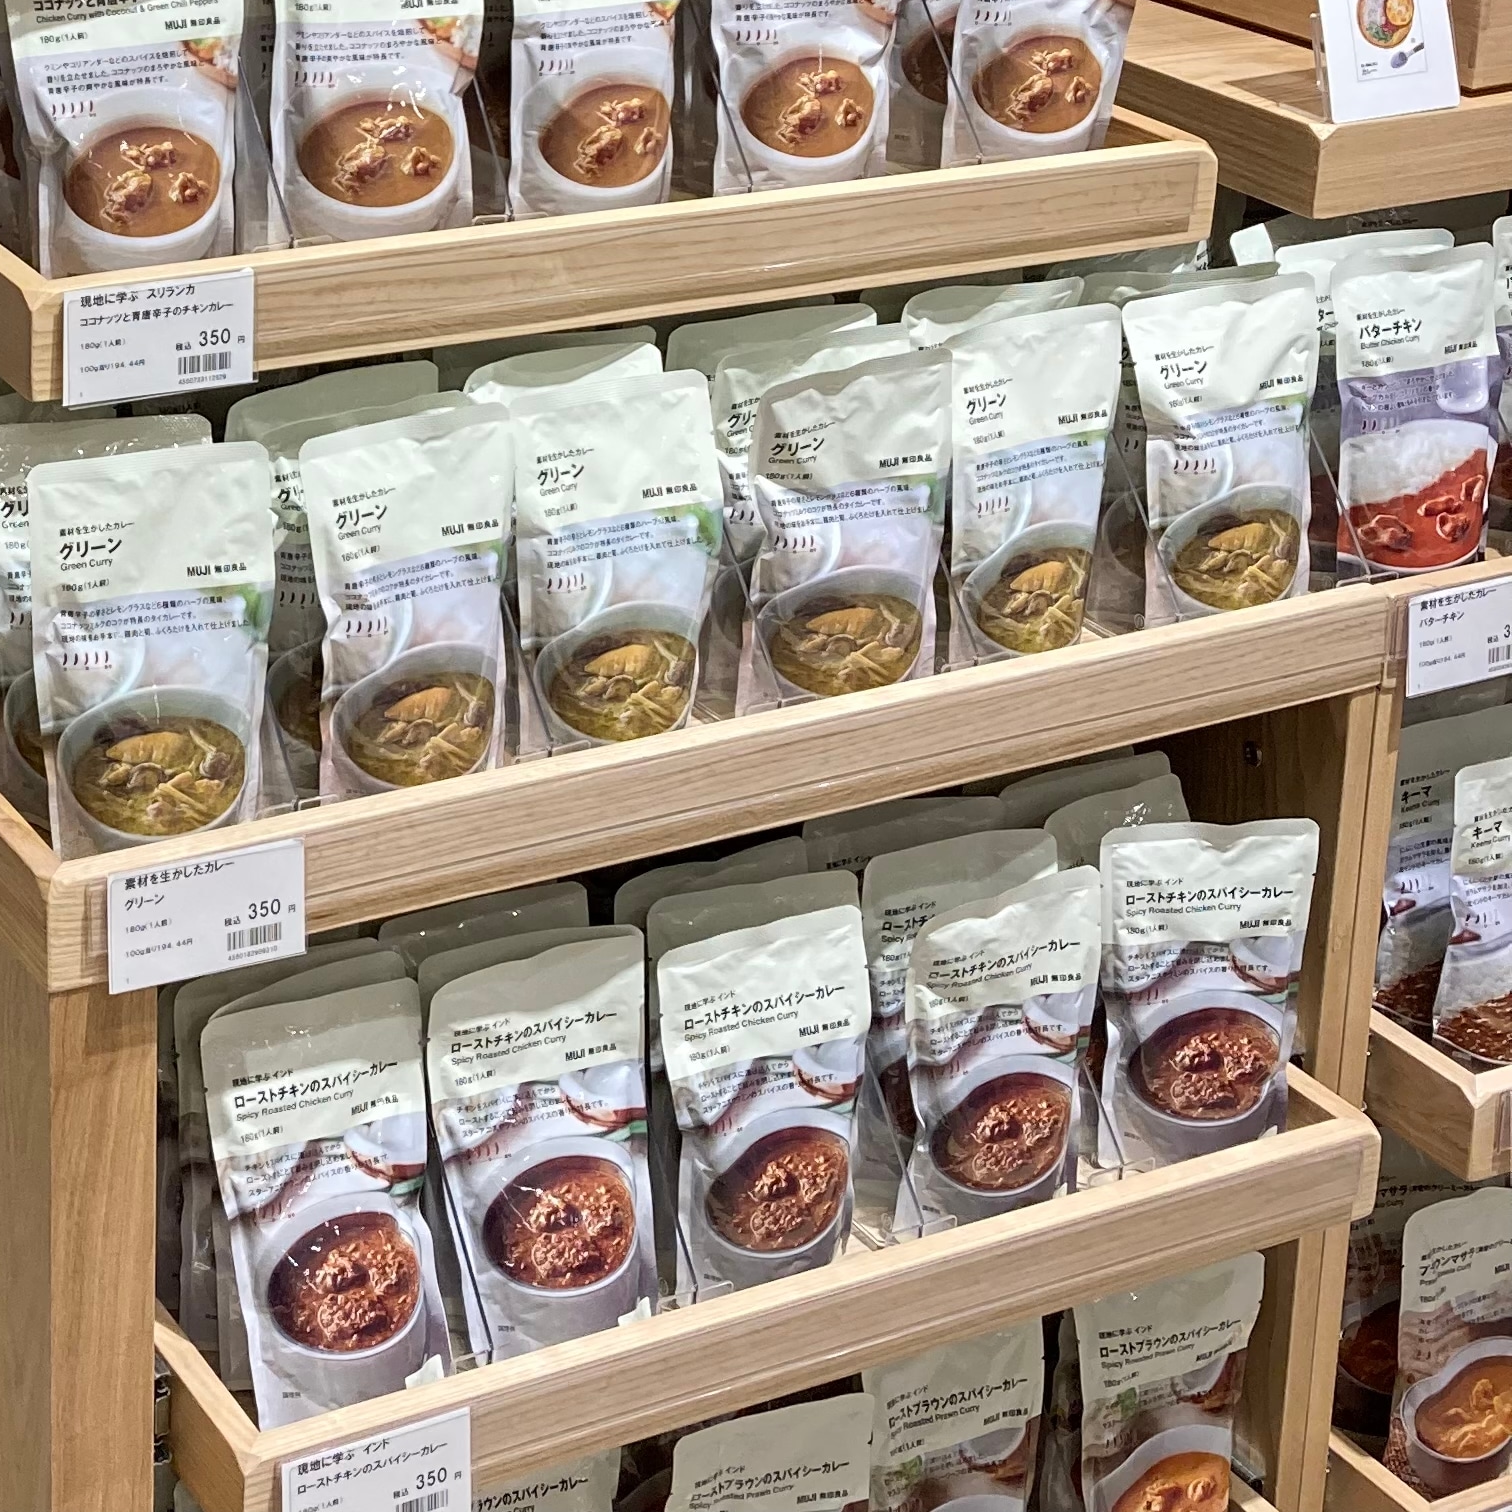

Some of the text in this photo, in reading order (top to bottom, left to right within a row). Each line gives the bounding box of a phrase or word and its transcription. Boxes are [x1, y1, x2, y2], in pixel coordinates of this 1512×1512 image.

[36, 13, 65, 24] Chicken
[67, 11, 86, 21] Curry
[89, 9, 104, 18] with
[106, 6, 137, 17] Coconut
[140, 4, 145, 12] &
[147, 2, 169, 12] Green
[81, 284, 195, 307] 現地に学ぶ スリランカ
[80, 302, 234, 326] ココナッツと青唐辛子のチキンカレー
[1359, 319, 1422, 339] バターチキン
[176, 342, 191, 351] 税込
[199, 328, 231, 346] 350
[1160, 360, 1207, 380] グリーン
[966, 393, 1006, 415] グリーン
[1058, 414, 1078, 425] MUJI
[771, 438, 825, 456] グリーン
[768, 455, 816, 464] Green Curry
[537, 464, 584, 486] グリーン
[336, 505, 387, 530] グリーン
[59, 521, 134, 537] 素材を生かしたカレー
[338, 525, 381, 541] Green Curry
[441, 524, 464, 537] MUJI
[59, 538, 122, 560] グリーン
[61, 558, 113, 571] Green Curry
[187, 563, 247, 576] MUJI 無印良品
[1419, 612, 1464, 627] バターチキン
[1401, 786, 1432, 804] キーマ
[1473, 821, 1503, 839] キーマ
[125, 860, 235, 890] 素材を生かしたカレー
[124, 895, 165, 911] グリーン
[1126, 887, 1293, 905] ローストチキンのスパイシーカレー
[248, 898, 281, 919] 350
[288, 904, 296, 913] 円
[1240, 920, 1259, 929] MUJI
[929, 939, 1080, 980] ローストチキンのスパイシーカレー
[718, 990, 736, 1000] インド
[684, 985, 845, 1030] ローストチキンのスパイシーカレー
[451, 1011, 617, 1052] ローストチキンのスパイシーカレー
[492, 1018, 511, 1028] インド
[272, 1069, 294, 1079] インド
[234, 1061, 398, 1108] ローストチキンのスパイシーカレー
[237, 1090, 354, 1121] Spicy Roasted Chicken Curry
[297, 1438, 390, 1475] 現地に学ぶ インド
[297, 1442, 448, 1494] ローストチキンのスパイシーカレー
[416, 1467, 447, 1490] 350
[454, 1471, 462, 1480] 円
